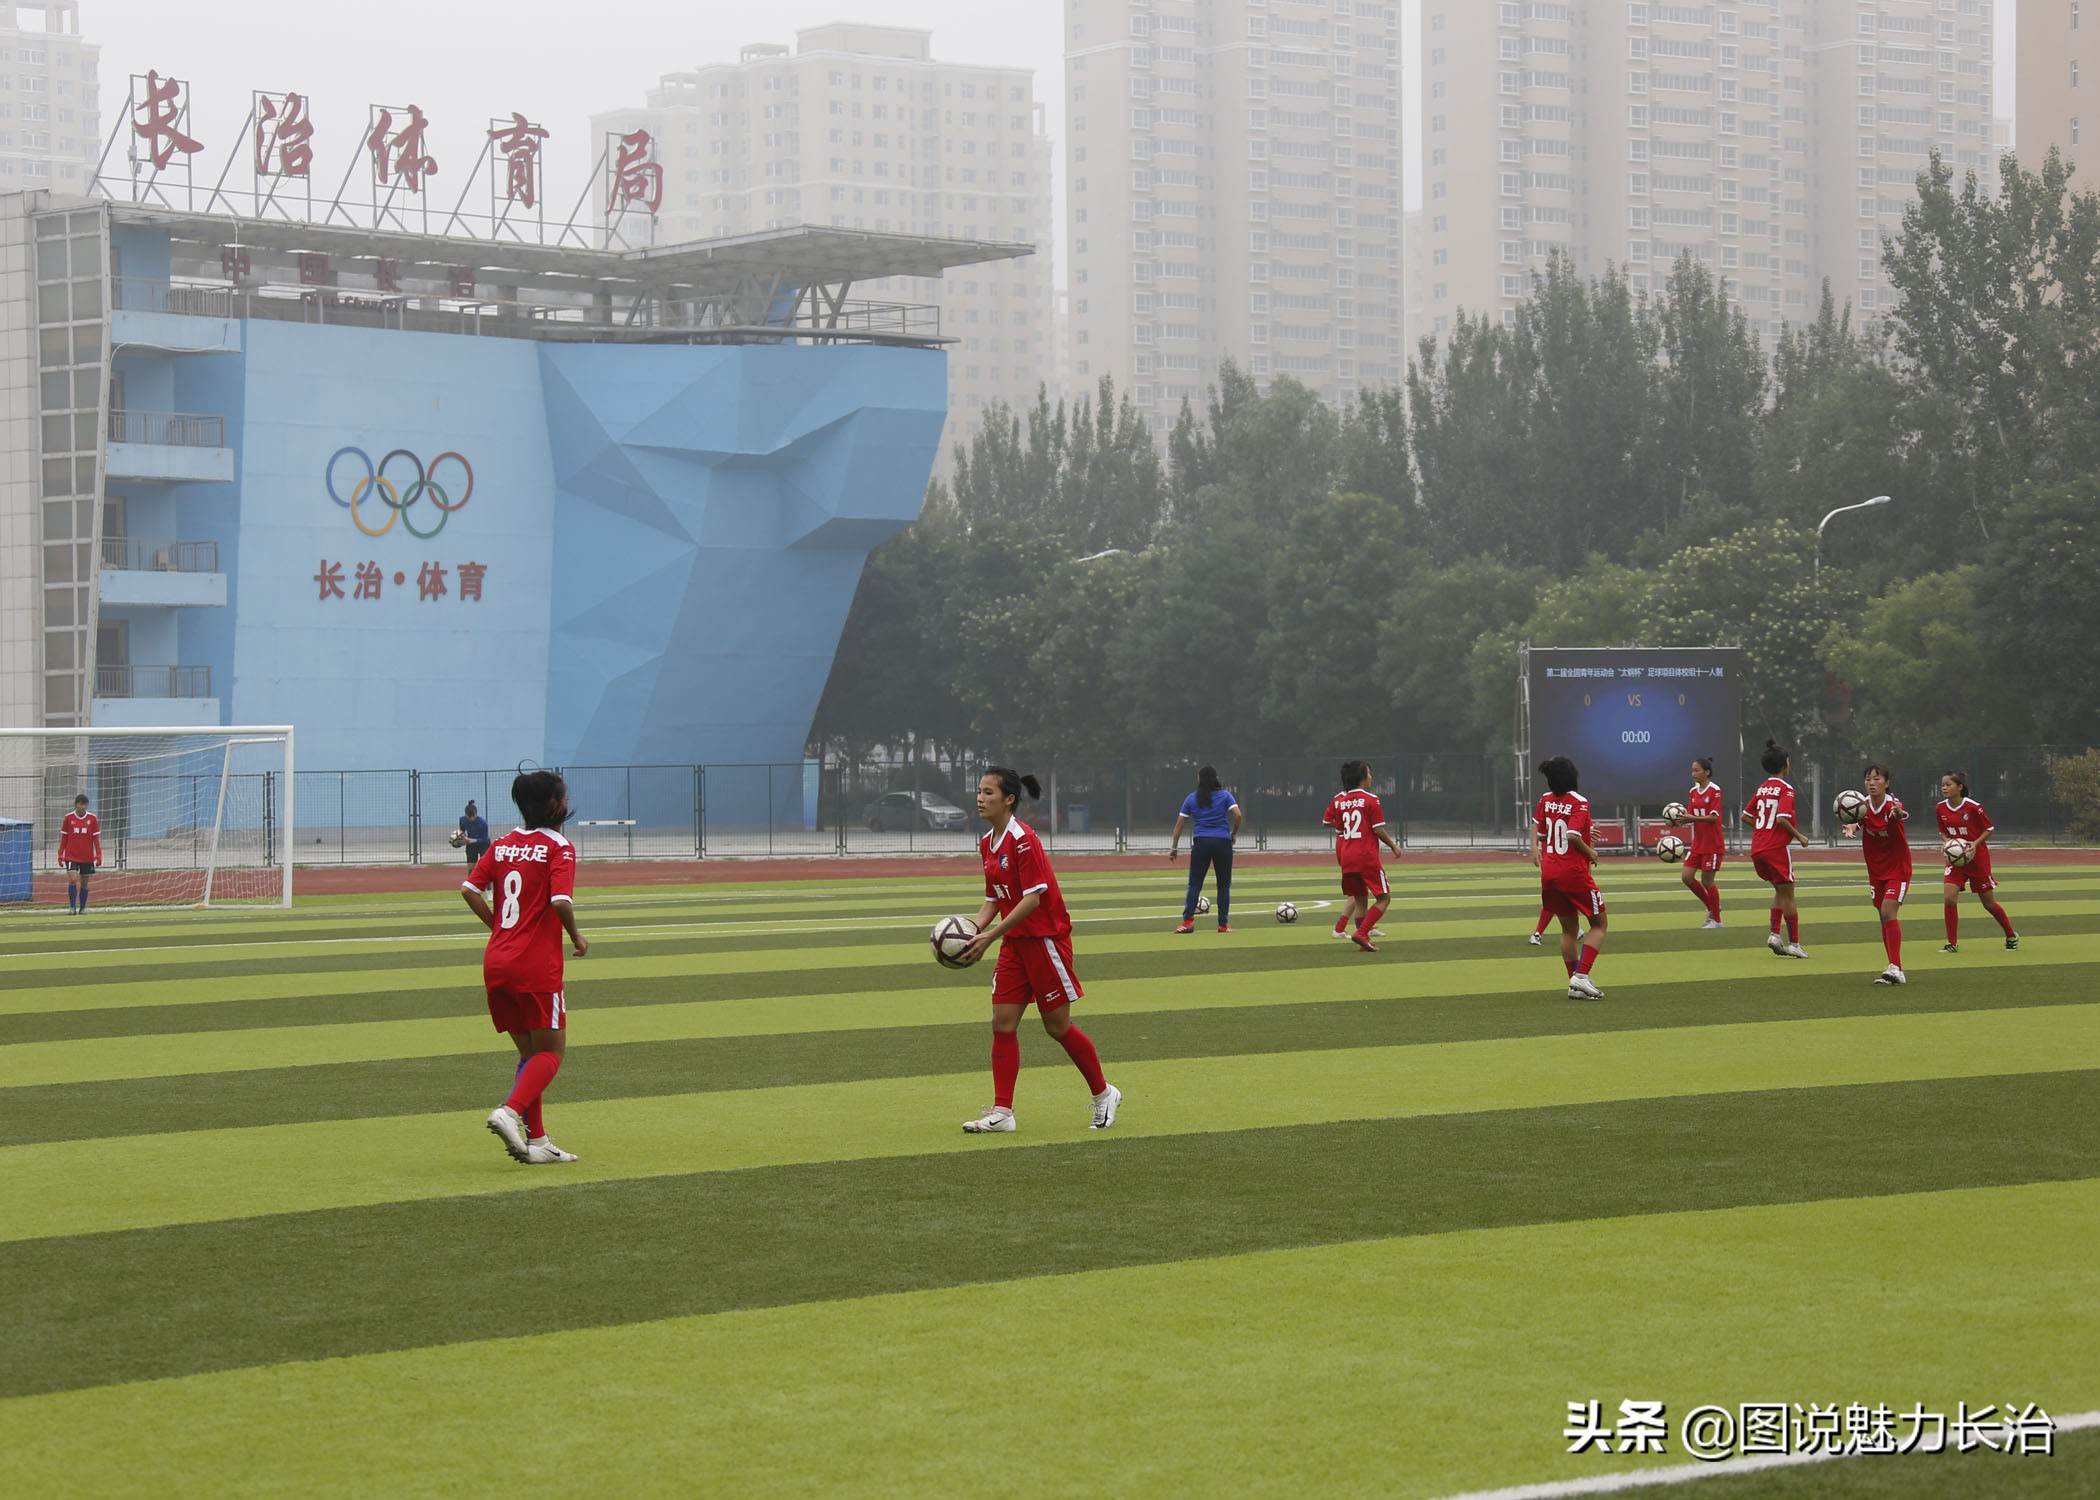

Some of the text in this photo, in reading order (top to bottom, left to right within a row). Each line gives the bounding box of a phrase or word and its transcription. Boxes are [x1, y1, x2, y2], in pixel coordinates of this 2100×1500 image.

[131, 68, 664, 214] 长治体育局
[313, 559, 488, 602] 长治·体育
[1584, 693, 1686, 707] 0 VS 0
[1621, 730, 1651, 744] 00:00
[1342, 809, 1362, 840] 32
[1755, 798, 1779, 830] 37
[500, 869, 523, 930] 8
